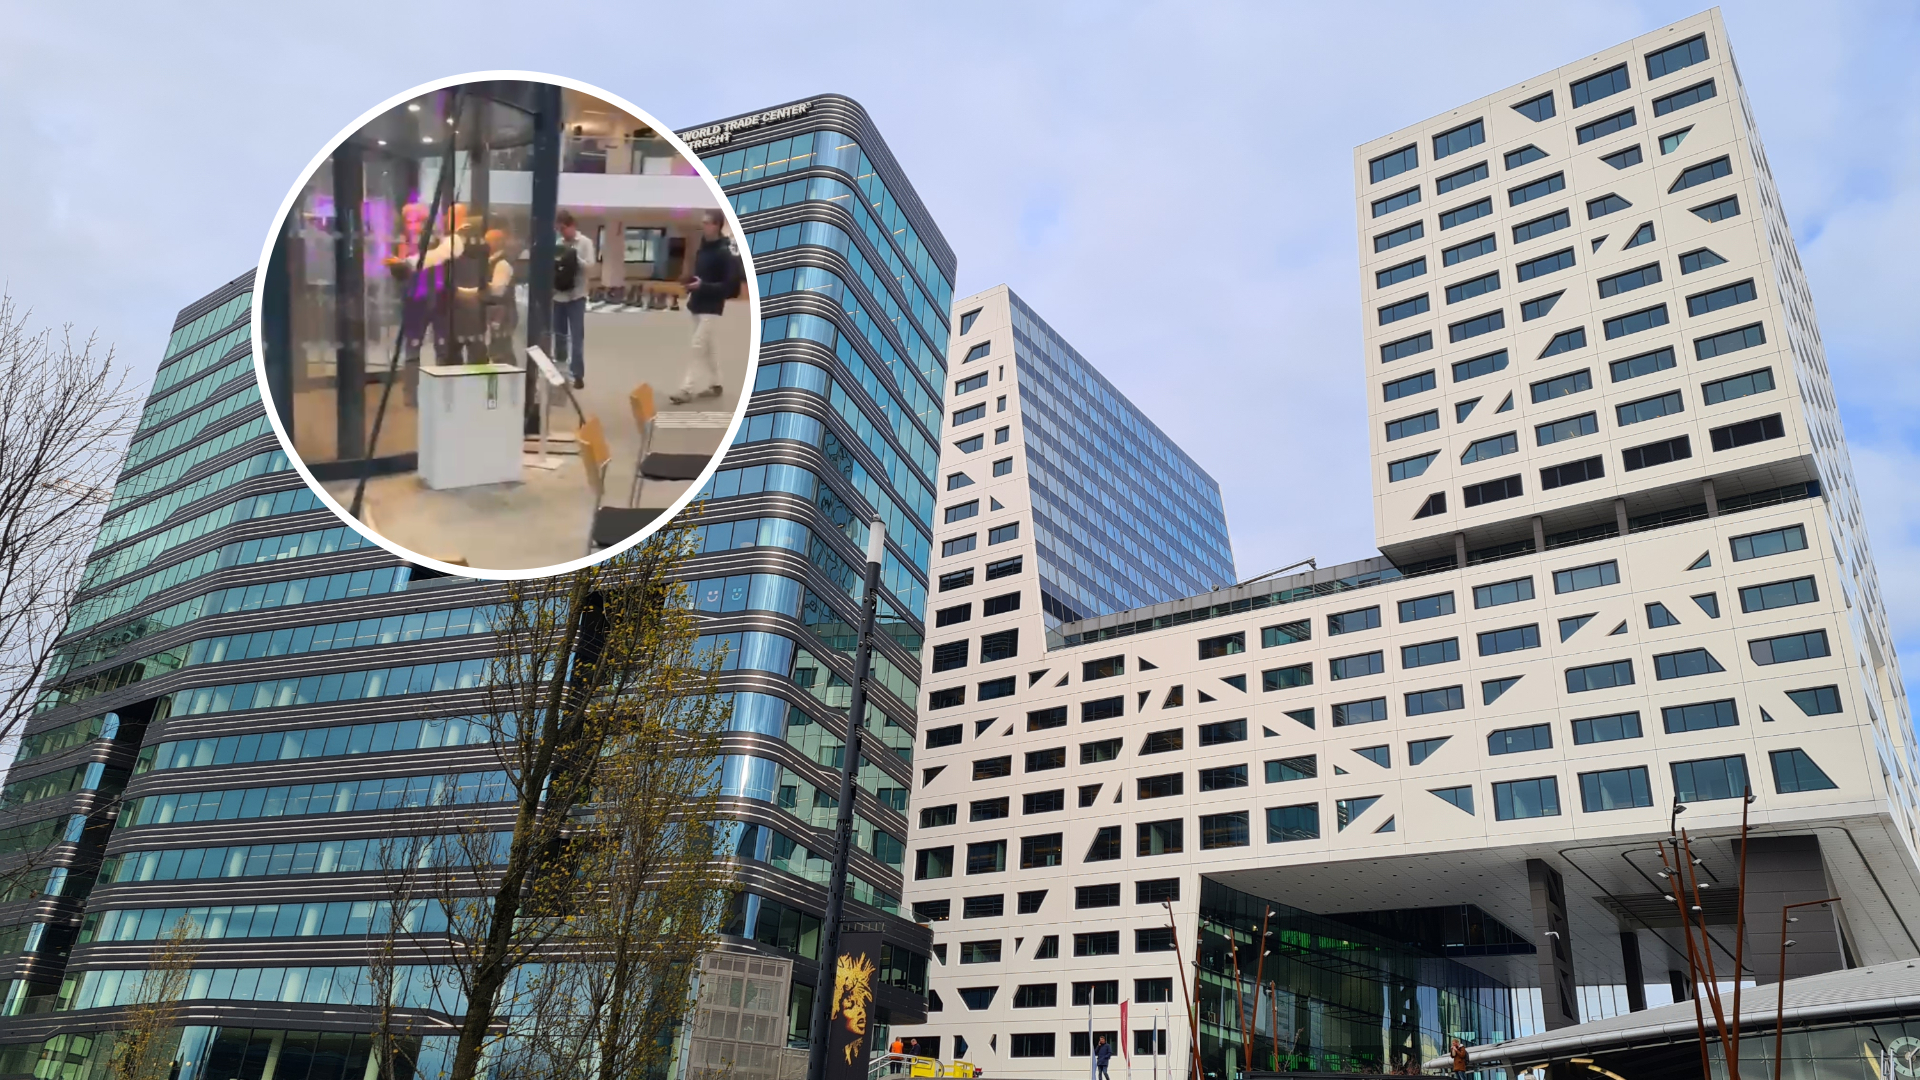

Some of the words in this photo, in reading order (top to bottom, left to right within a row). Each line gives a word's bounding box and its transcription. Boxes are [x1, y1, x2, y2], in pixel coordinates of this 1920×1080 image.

[682, 125, 721, 142] WORLD
[724, 115, 760, 131] TRADE
[685, 132, 731, 150] TRECHT
